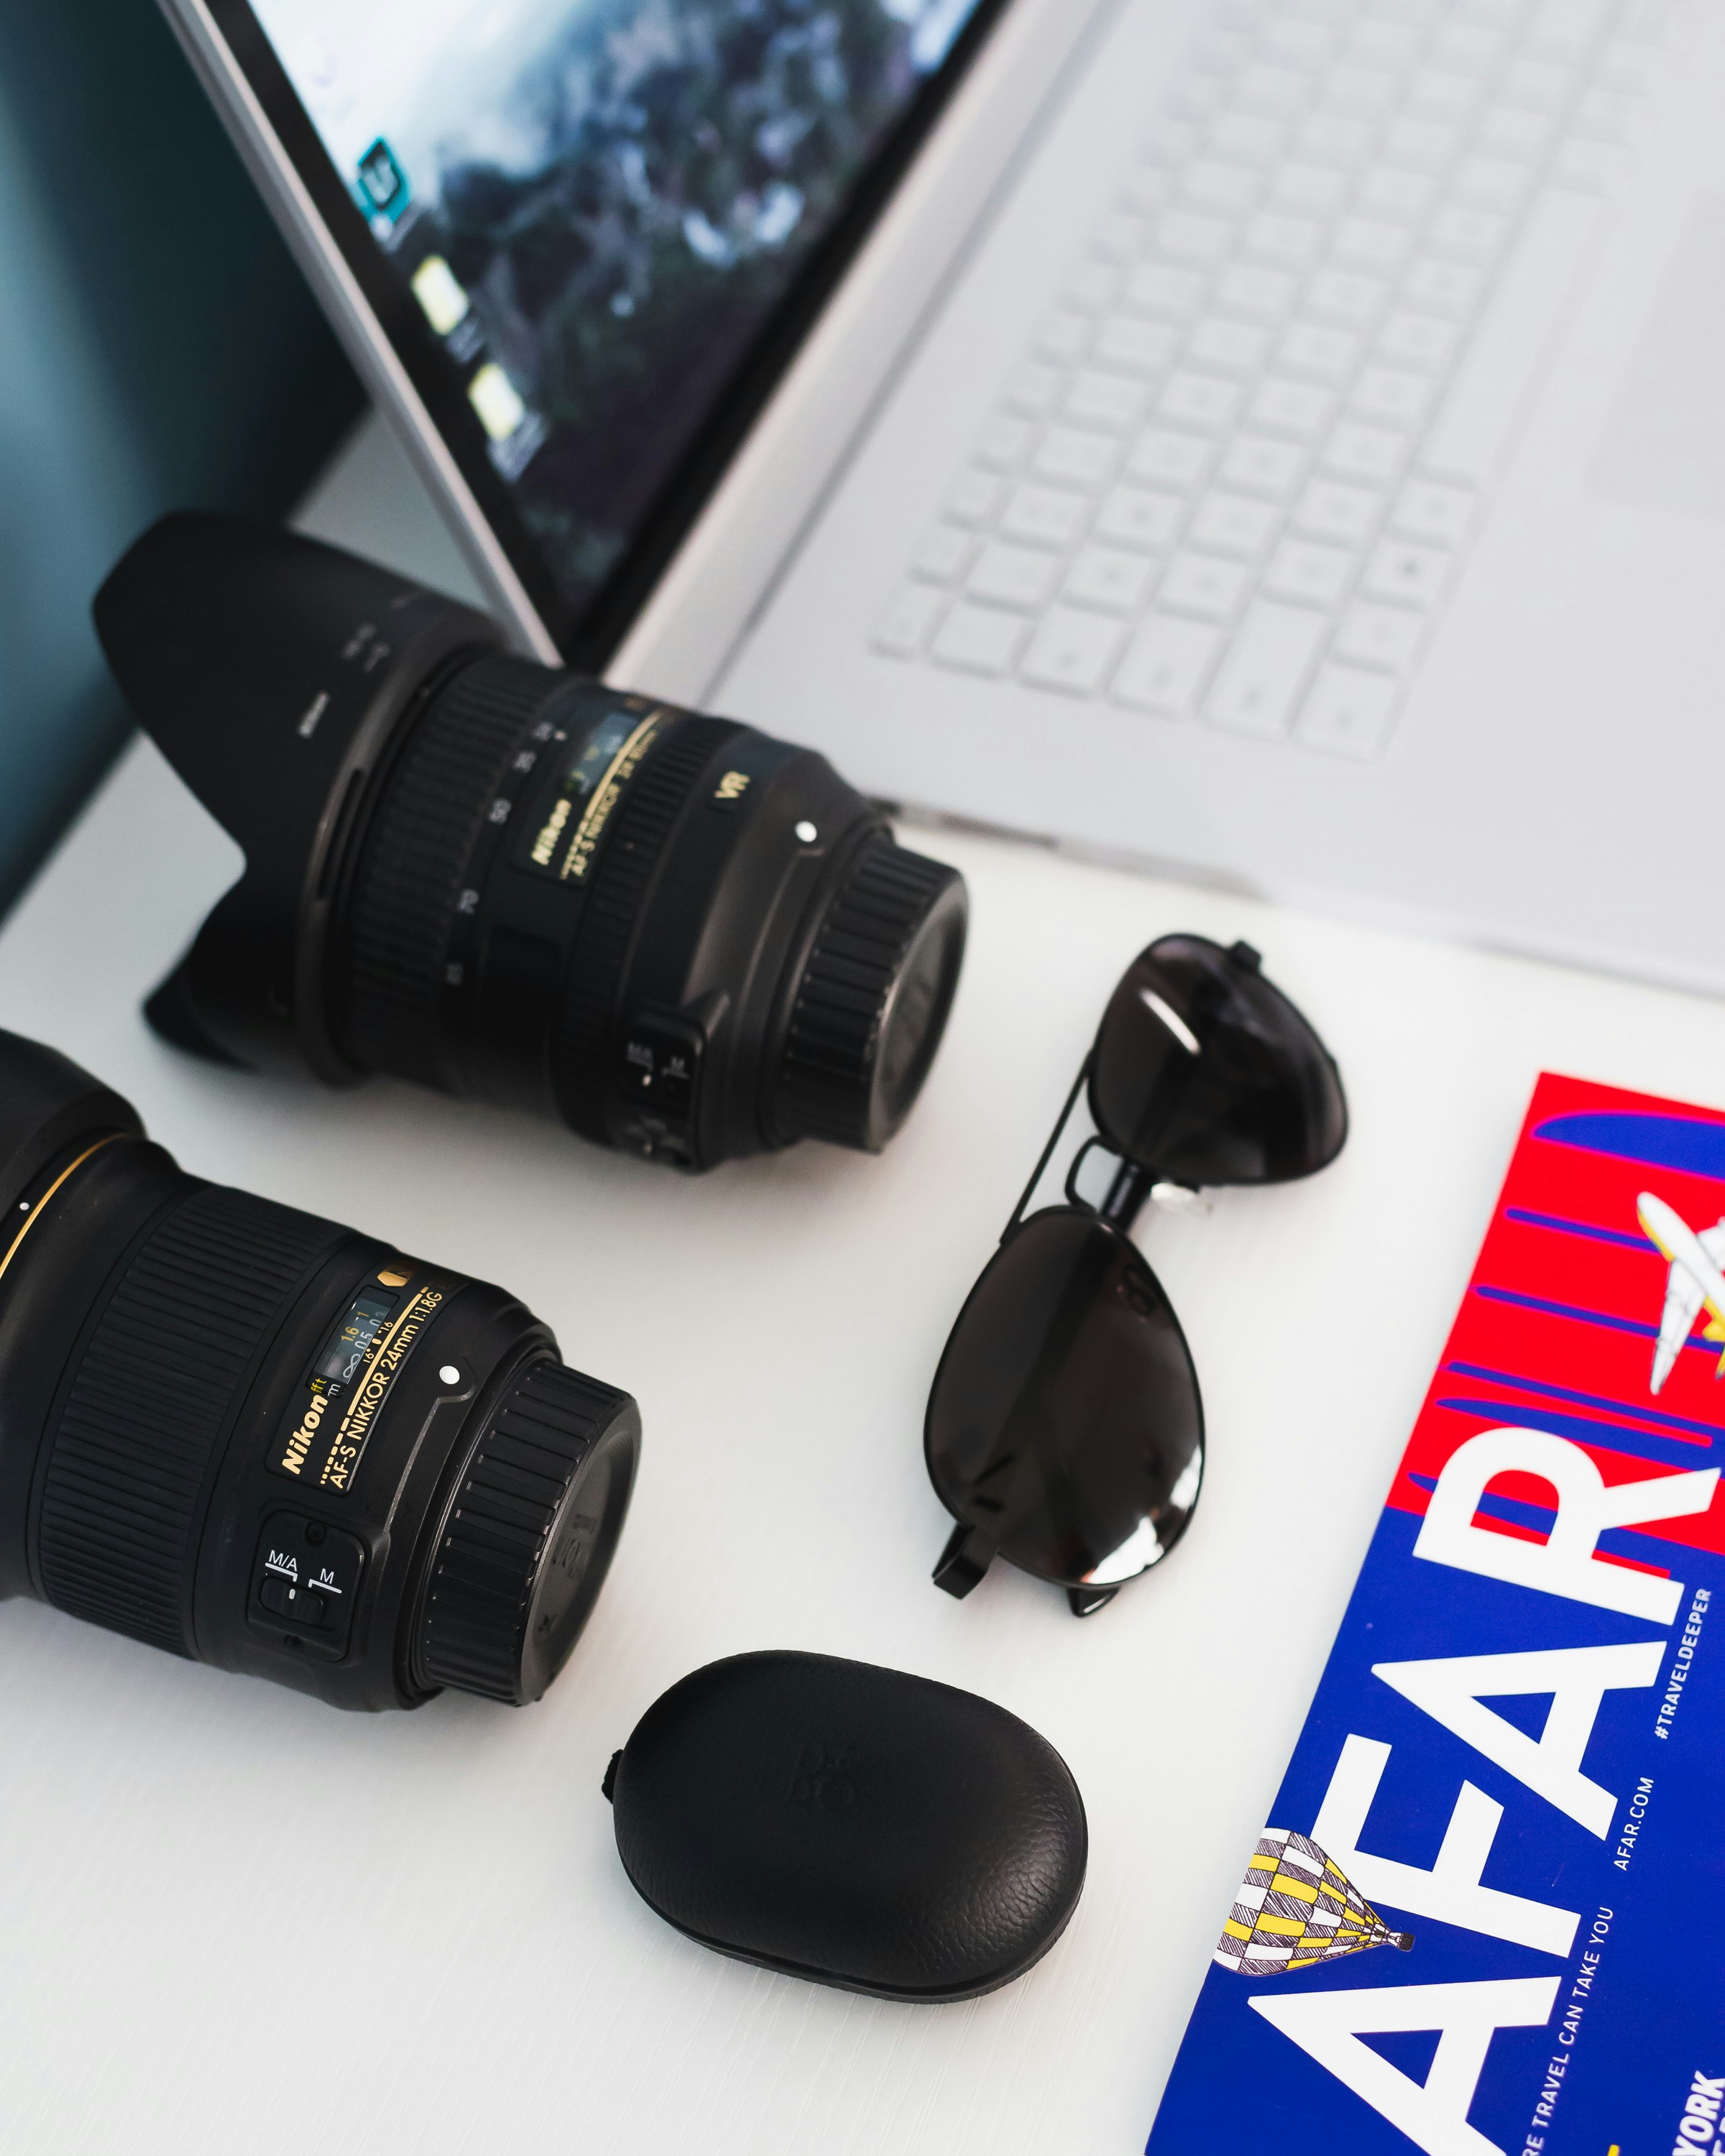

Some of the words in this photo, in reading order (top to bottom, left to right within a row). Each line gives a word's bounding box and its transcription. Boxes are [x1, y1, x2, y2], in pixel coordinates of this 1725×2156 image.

[530, 798, 571, 865] Nikon
[341, 1326, 359, 1342] 1.6
[282, 1394, 328, 1475] Nikon
[330, 1445, 356, 1489] AF-S
[346, 1372, 390, 1440] NIKKOR
[380, 1325, 420, 1371] 24mm
[409, 1291, 443, 1322] 1:1.8G
[269, 1549, 298, 1572] M/A
[320, 1568, 334, 1584] M
[1655, 1588, 1712, 1740] #TRAVELDEEPER
[1247, 1427, 1721, 2156] AFAR
[1614, 1777, 1655, 1871] AFAR.COM
[1532, 2053, 1570, 2128] TRAVEL
[1558, 2004, 1583, 2046] CAN
[1572, 1950, 1600, 1998] TAKE
[1588, 1907, 1614, 1944] YOU
